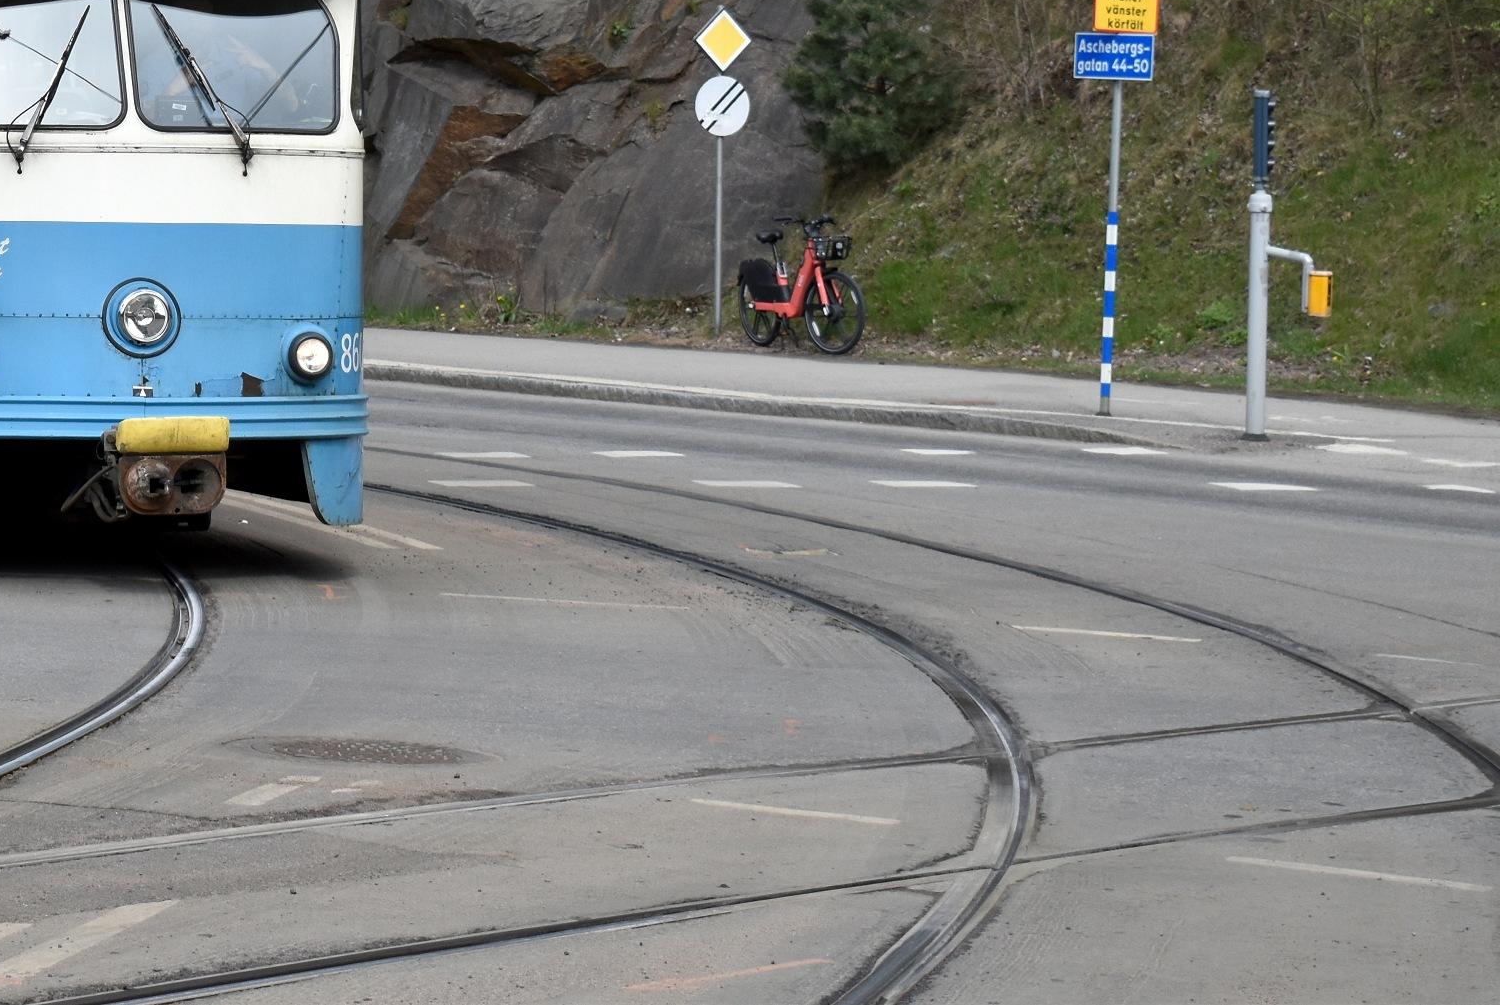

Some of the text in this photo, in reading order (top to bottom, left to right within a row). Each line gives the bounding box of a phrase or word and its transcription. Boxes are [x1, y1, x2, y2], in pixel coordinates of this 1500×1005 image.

[1106, 4, 1147, 16] vänster
[1107, 18, 1144, 30] körfält
[1078, 39, 1150, 57] Aschebergs-
[1077, 58, 1149, 74] gatan 44-50
[341, 332, 363, 373] 86
